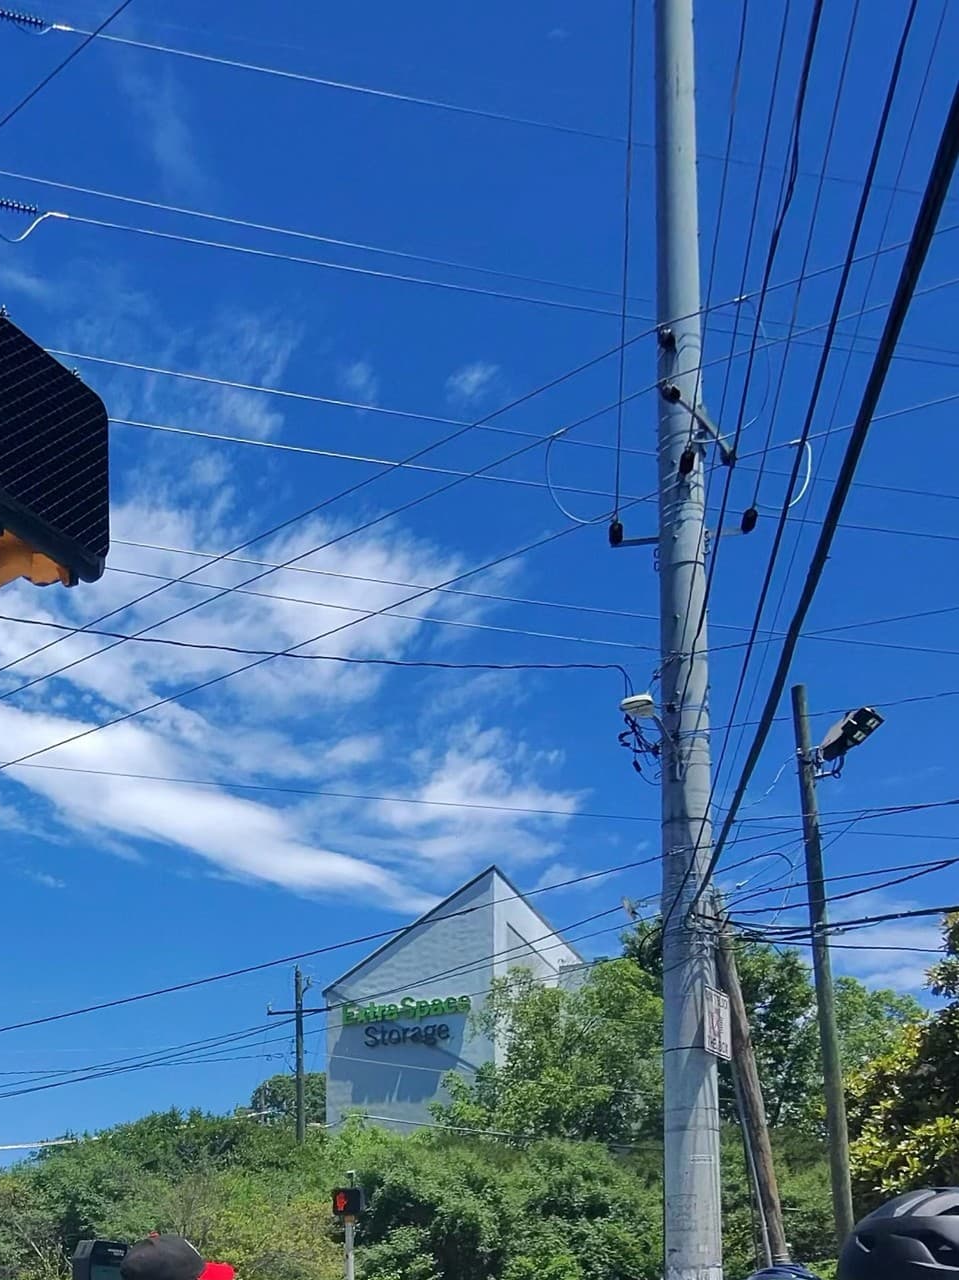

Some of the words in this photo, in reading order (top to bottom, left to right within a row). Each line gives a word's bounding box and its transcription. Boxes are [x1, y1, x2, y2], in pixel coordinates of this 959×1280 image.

[342, 1001, 398, 1025] Extra
[400, 994, 472, 1021] Space
[364, 1023, 451, 1048] Storage
